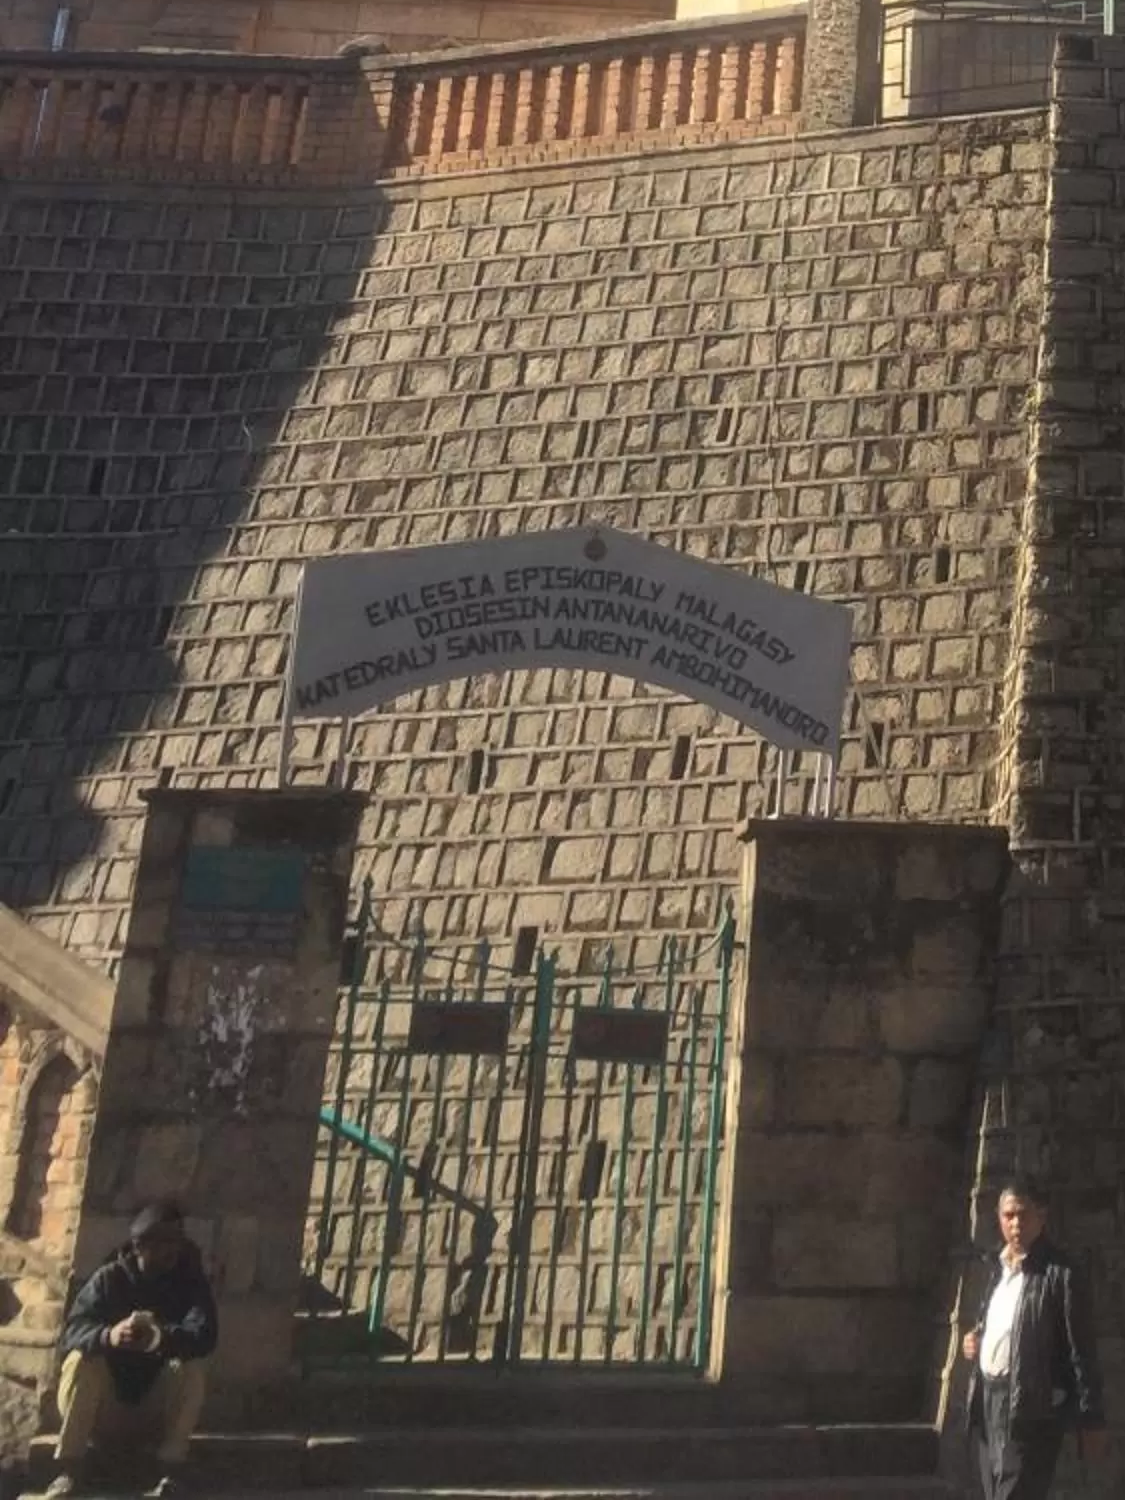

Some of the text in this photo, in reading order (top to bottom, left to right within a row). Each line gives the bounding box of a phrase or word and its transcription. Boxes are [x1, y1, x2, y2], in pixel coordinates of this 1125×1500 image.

[364, 567, 796, 664] EKLESIA EPISKOPALY MALAGASY
[413, 596, 748, 670] DIOSESIN ANTANANARIVO
[296, 627, 829, 746] KATEDRALY SANTA LAURENT AMBOHIMANORO
